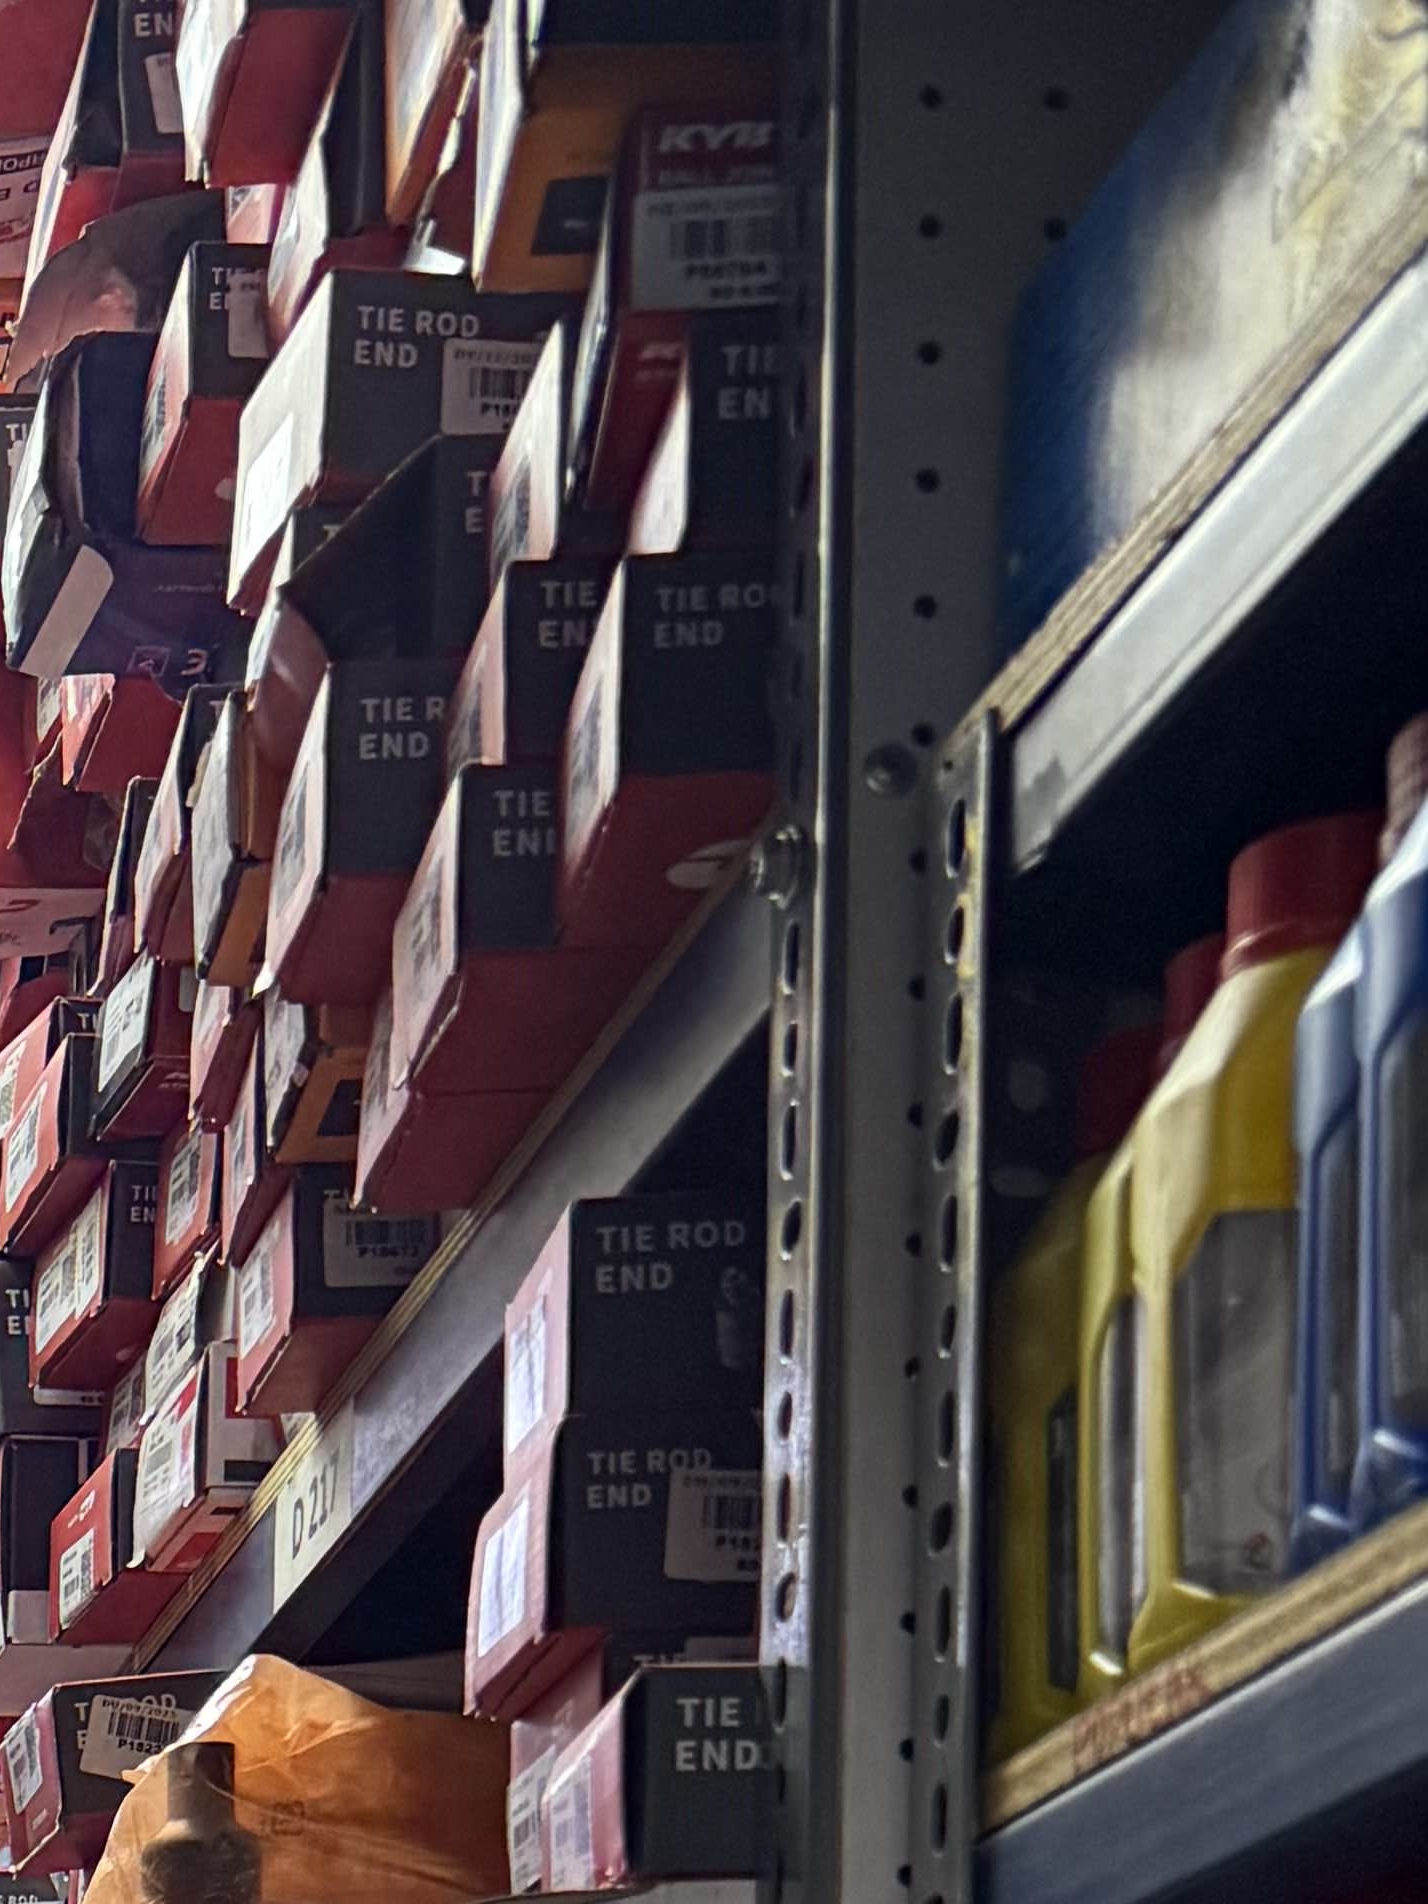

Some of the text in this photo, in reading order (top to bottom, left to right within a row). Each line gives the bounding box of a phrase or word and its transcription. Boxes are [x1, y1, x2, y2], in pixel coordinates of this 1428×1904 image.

[357, 307, 479, 338] TIE ROD
[354, 342, 418, 369] END
[656, 588, 708, 610] TIE
[654, 622, 725, 648] END
[361, 698, 415, 723] TIE
[359, 733, 430, 759] END
[493, 791, 550, 818] TIE
[596, 1221, 744, 1251] TIE ROD
[595, 1265, 673, 1293] END
[587, 1448, 712, 1474] TIE ROD
[586, 1484, 652, 1508] END
[676, 1696, 742, 1728] TIE
[675, 1739, 761, 1770] END
